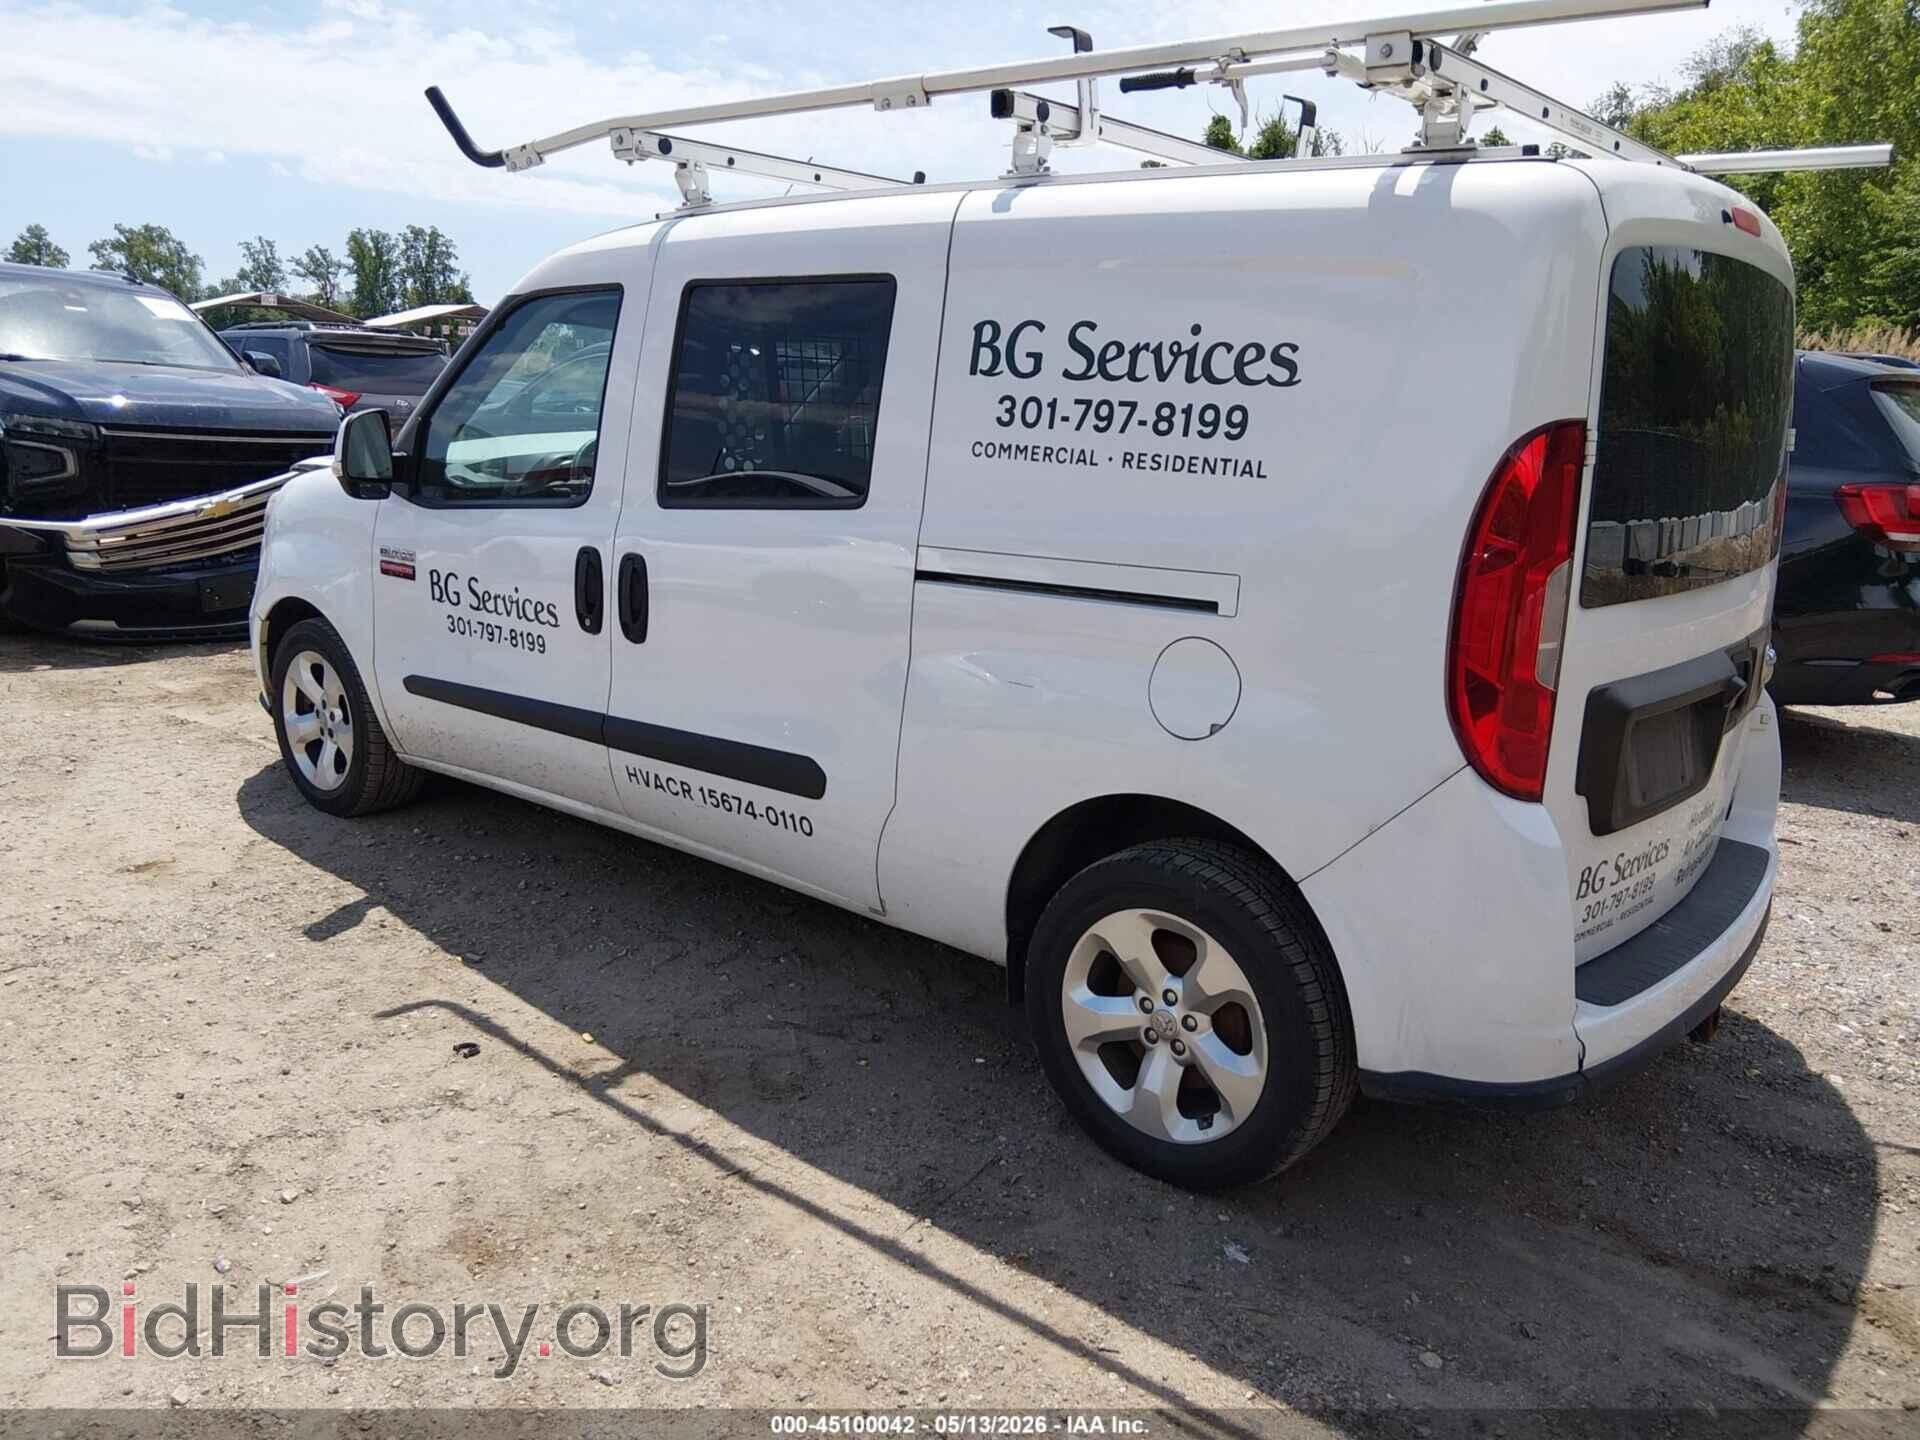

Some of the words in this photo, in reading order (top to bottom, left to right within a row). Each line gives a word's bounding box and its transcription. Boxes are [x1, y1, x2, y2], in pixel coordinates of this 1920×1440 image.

[969, 319, 1046, 380] BG
[1062, 319, 1302, 387] Services
[995, 395, 1250, 441] 301-797-8199
[971, 441, 1099, 467] COMMERCIAL
[1122, 452, 1268, 479] RESIDENTIAL
[429, 569, 462, 607] BG
[467, 576, 561, 628] Services
[446, 614, 546, 655] 301-797-8199
[625, 765, 694, 801] HVACR
[698, 786, 814, 837] 15674-0110
[1576, 860, 1608, 900] BG
[1610, 838, 1671, 887] Services
[1582, 872, 1656, 923] 301-797-8199
